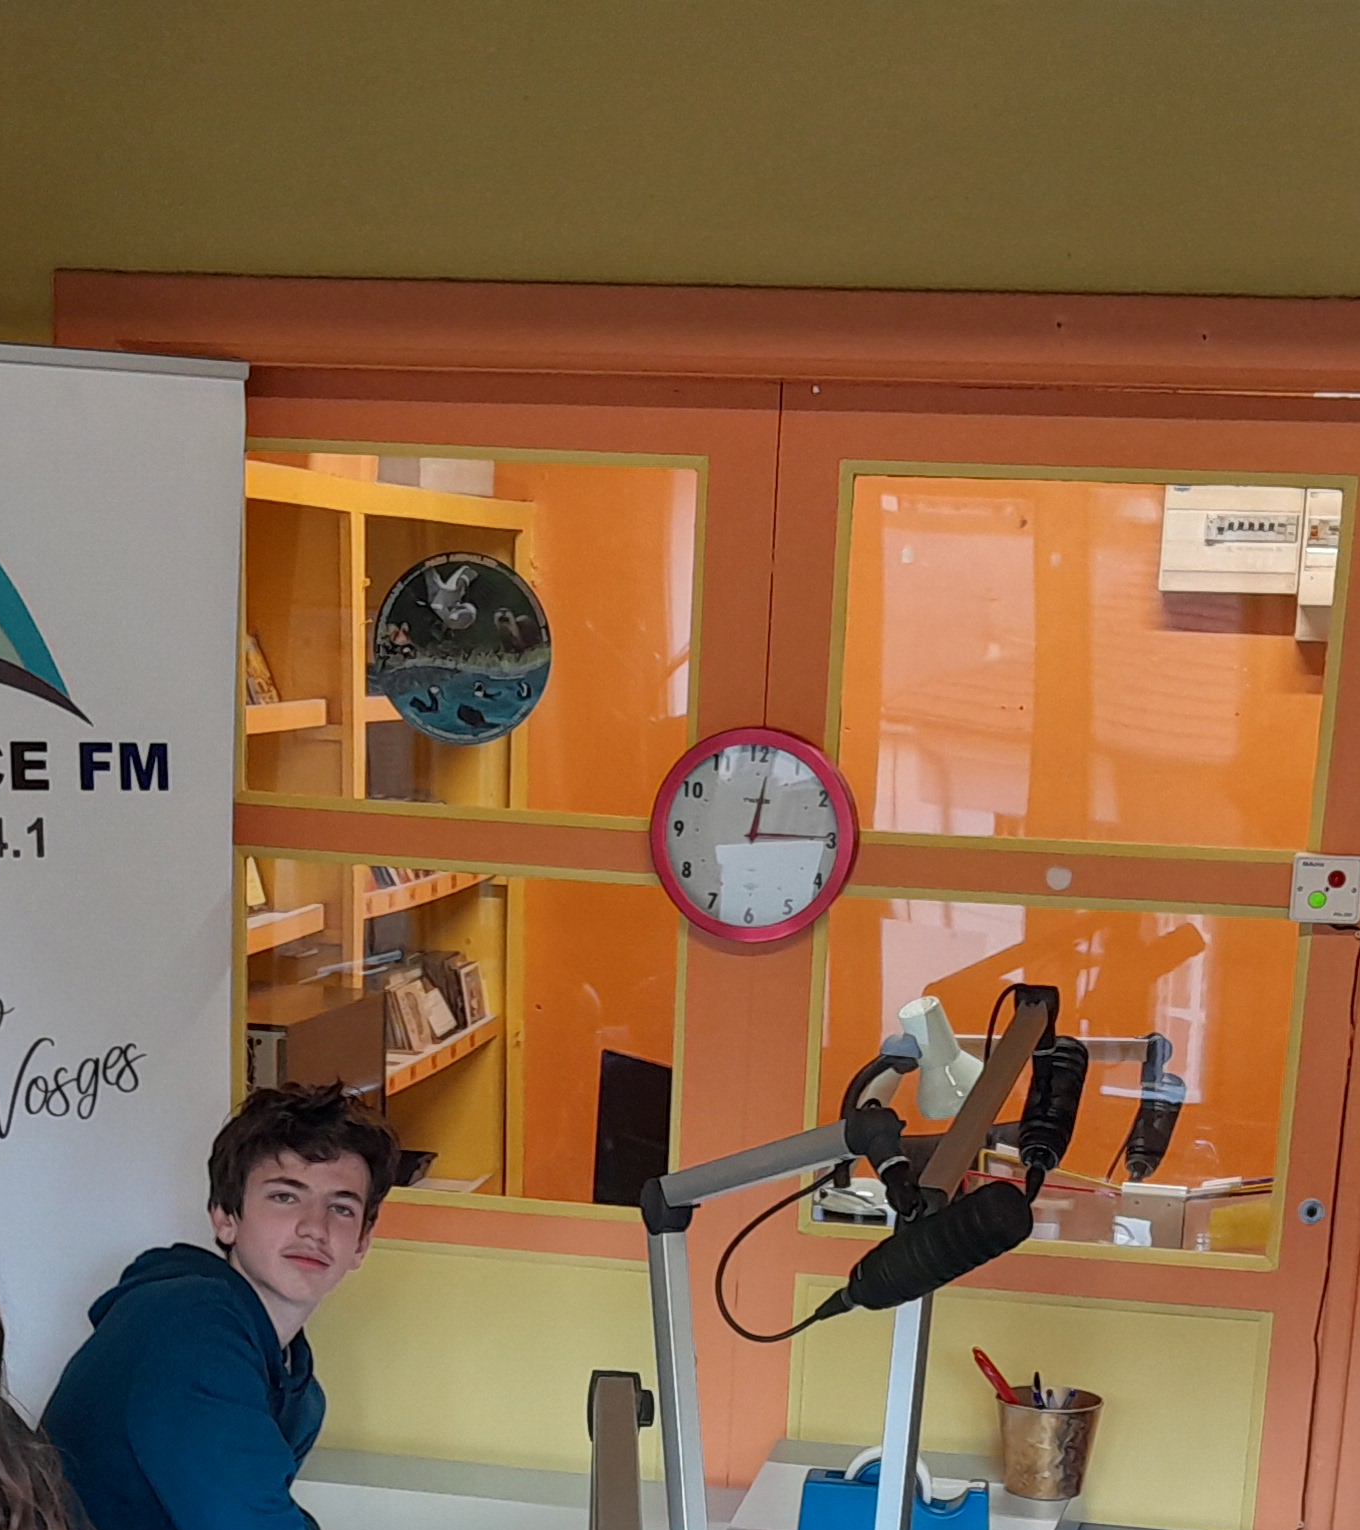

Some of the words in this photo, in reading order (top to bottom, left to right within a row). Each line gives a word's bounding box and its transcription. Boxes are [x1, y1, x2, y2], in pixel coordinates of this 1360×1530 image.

[750, 746, 769, 763] 12
[78, 741, 170, 792] FM
[713, 754, 731, 772] 11
[682, 781, 703, 798] 10
[818, 791, 829, 807] 2
[674, 820, 684, 837] 9
[826, 833, 837, 849] 3
[681, 862, 692, 878] 8
[813, 873, 822, 889] 4
[708, 893, 718, 909] 7
[782, 899, 794, 915] 5
[744, 907, 754, 924] 6
